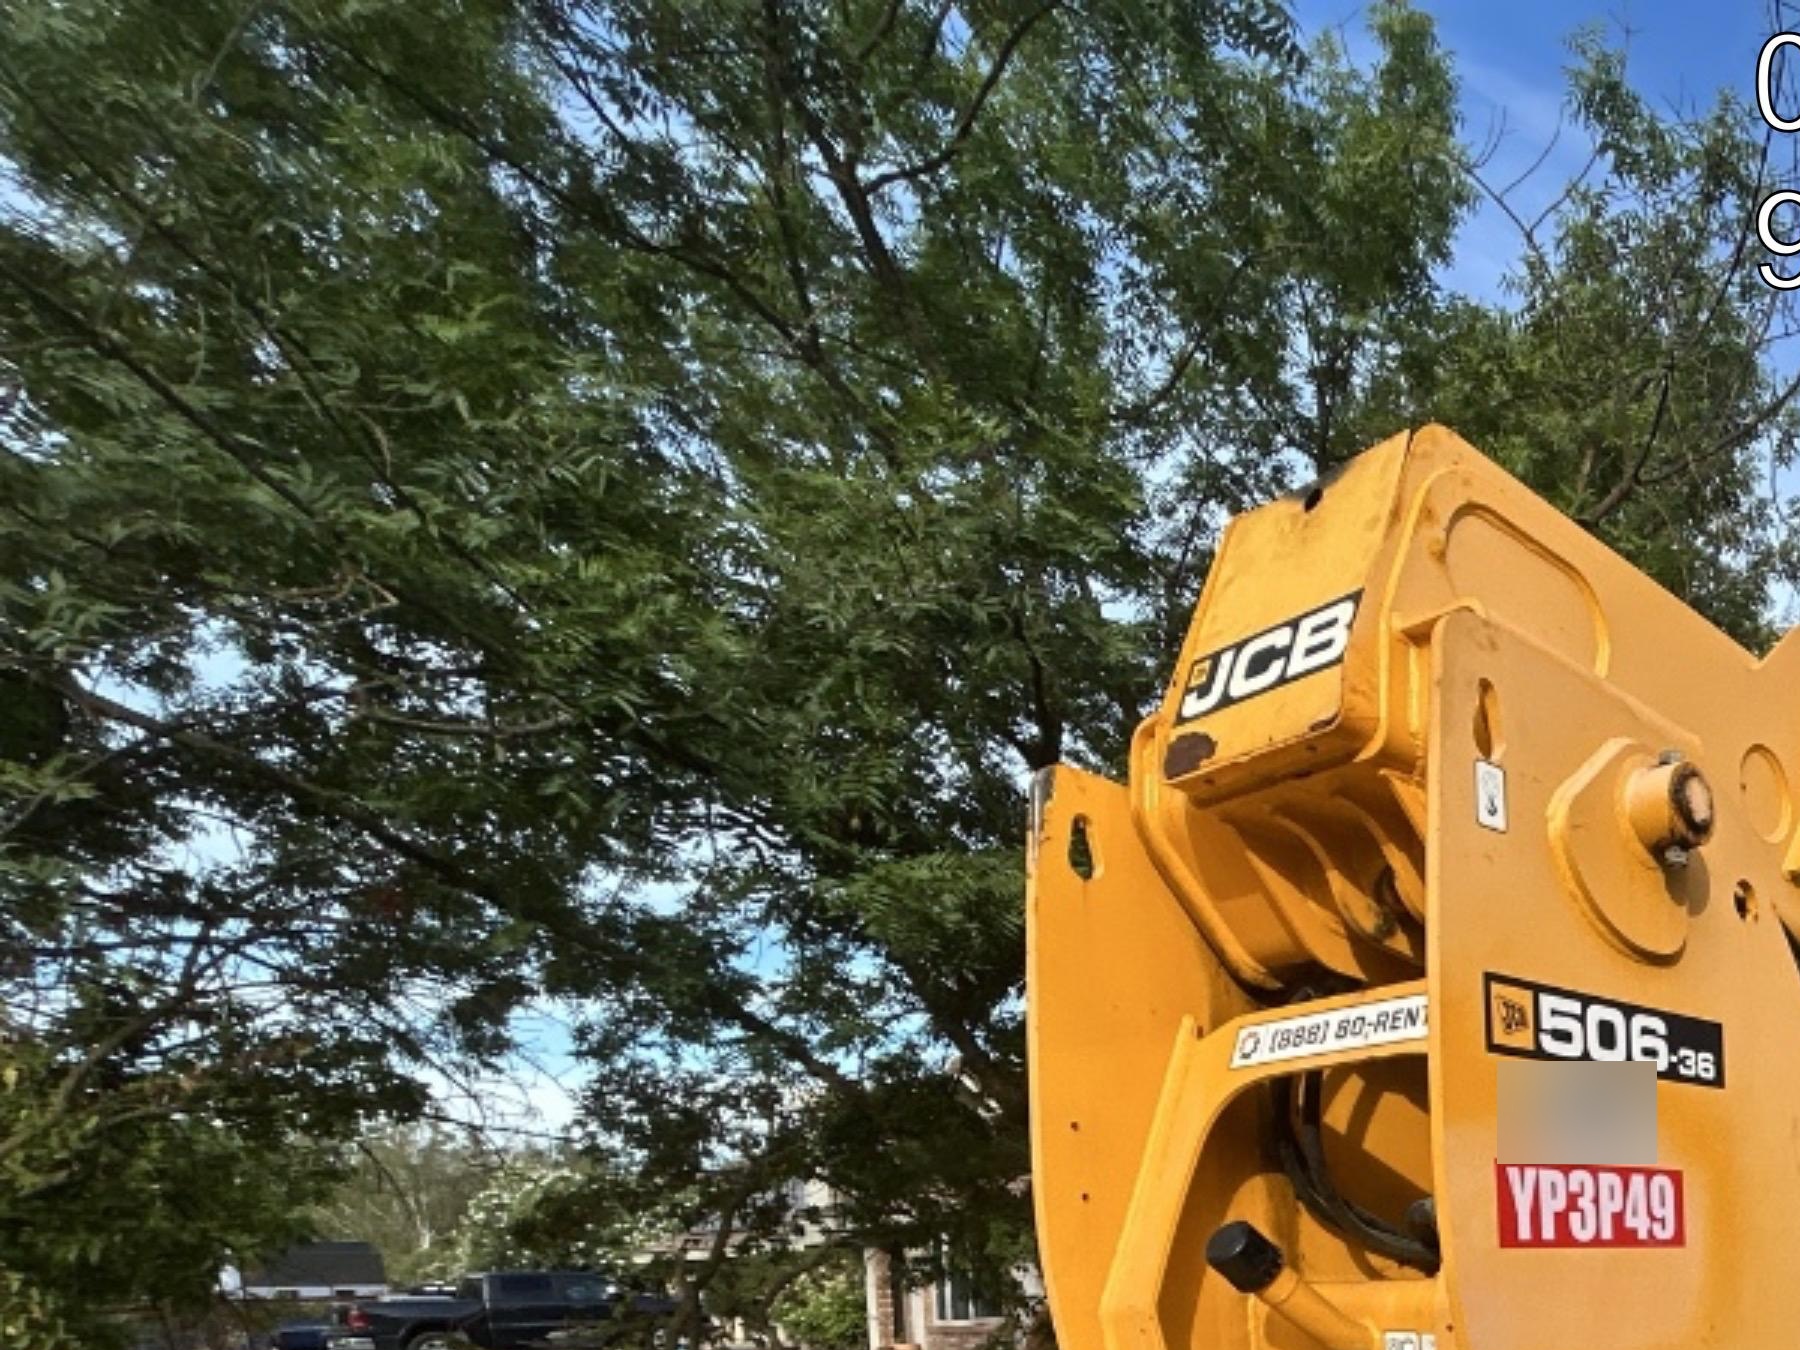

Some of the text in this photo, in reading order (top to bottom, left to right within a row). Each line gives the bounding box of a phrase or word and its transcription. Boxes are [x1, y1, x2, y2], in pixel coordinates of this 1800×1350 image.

[1180, 599, 1356, 719] JCB
[1268, 1019, 1330, 1054] (888)
[1505, 1166, 1677, 1243] YP3P49
